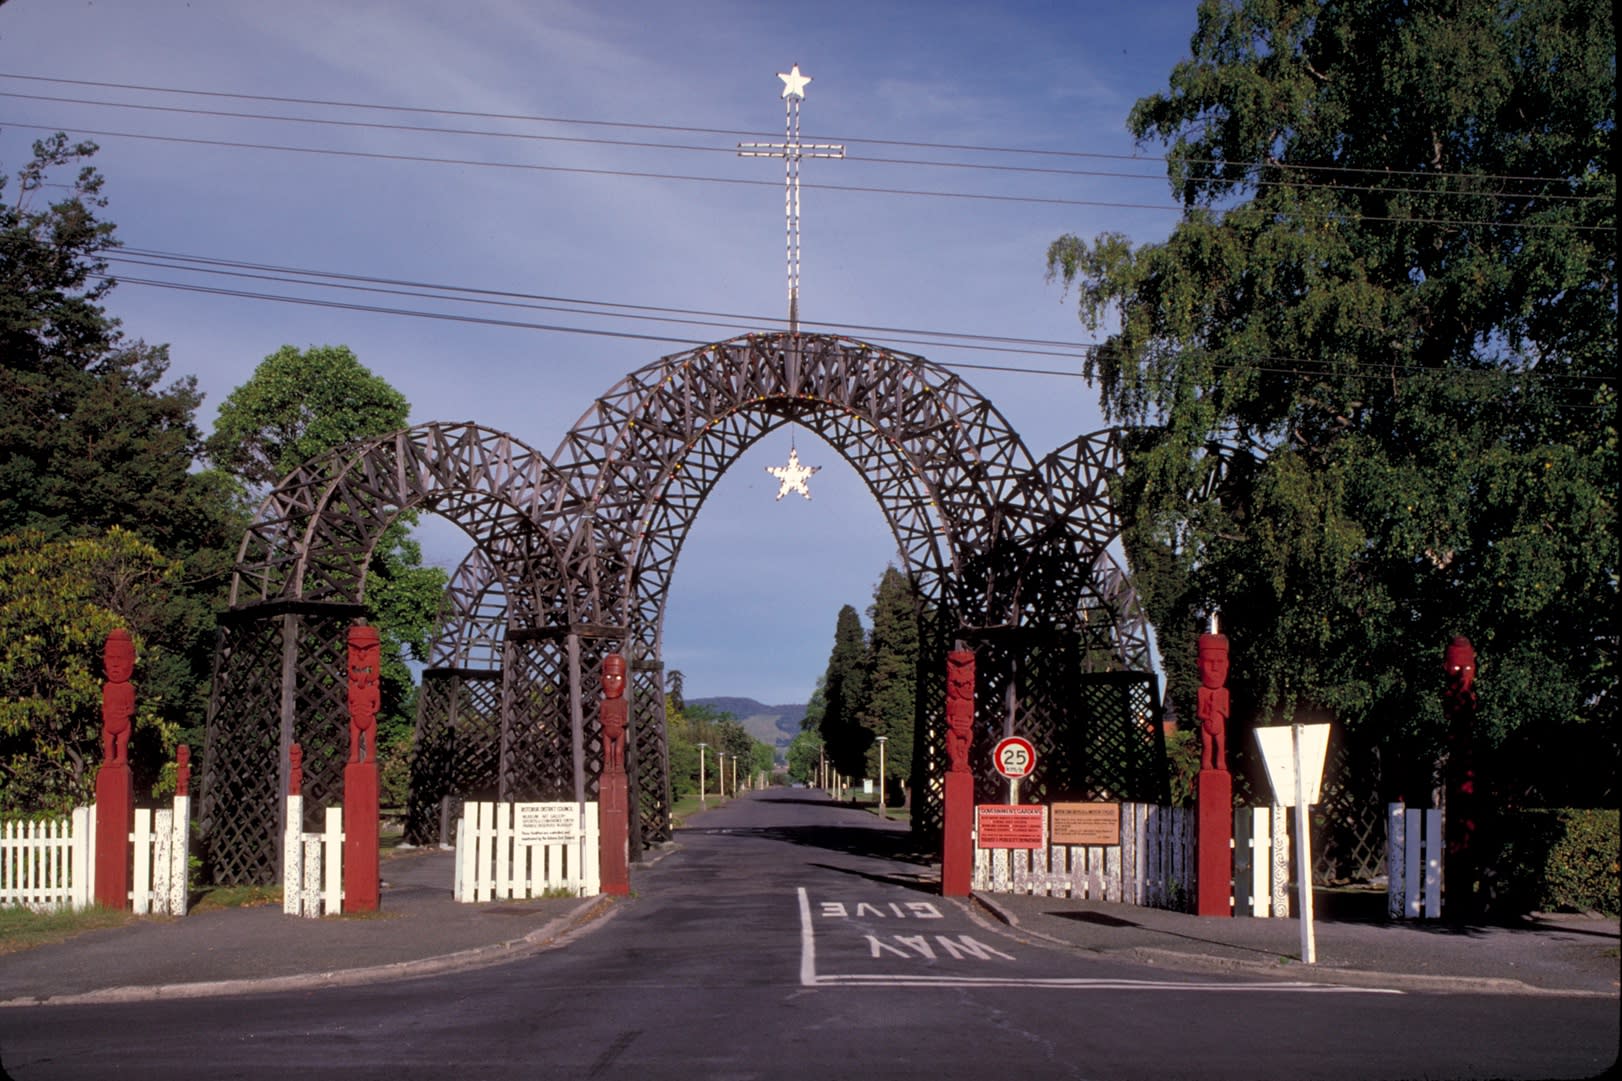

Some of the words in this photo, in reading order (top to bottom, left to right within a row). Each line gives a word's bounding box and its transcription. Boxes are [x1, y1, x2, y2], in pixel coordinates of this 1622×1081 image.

[1004, 749, 1026, 765] 25
[820, 901, 944, 918] GIVE
[864, 935, 1017, 960] WAY
